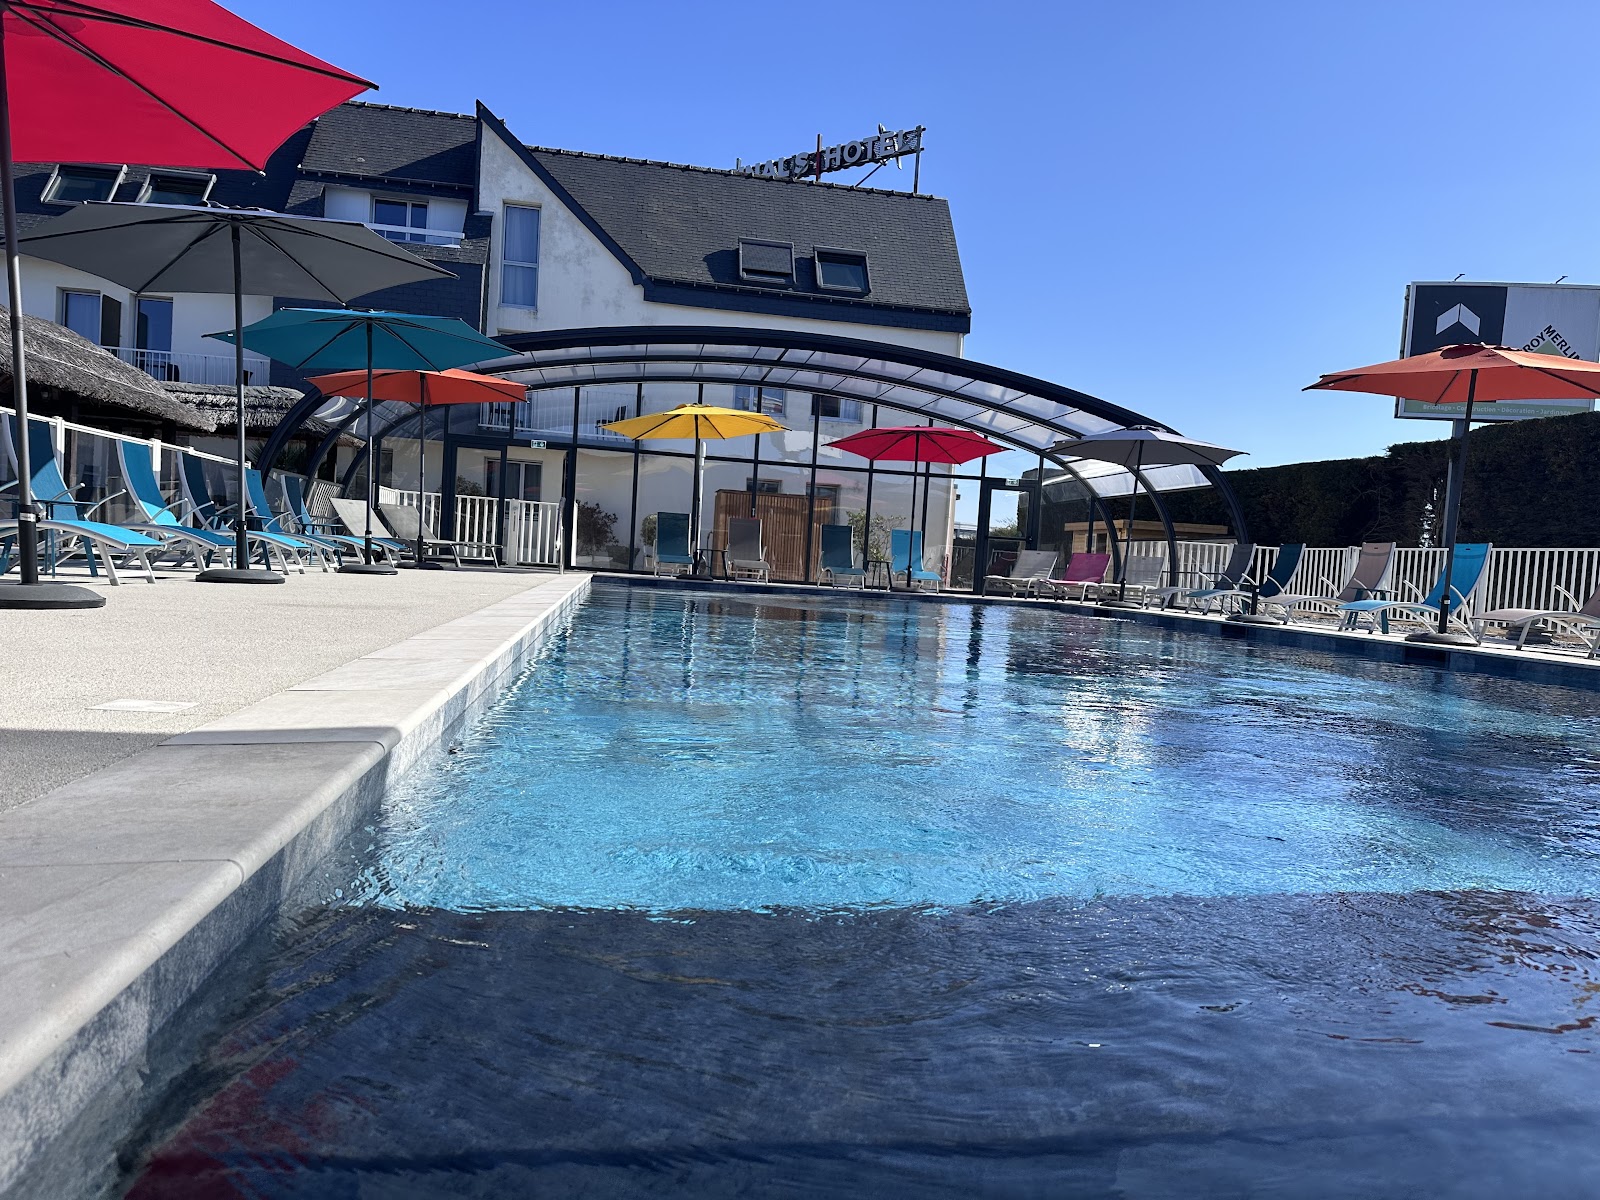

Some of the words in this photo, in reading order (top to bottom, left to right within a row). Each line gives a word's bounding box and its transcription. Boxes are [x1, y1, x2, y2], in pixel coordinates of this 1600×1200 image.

[824, 130, 910, 168] HOTEL
[1522, 332, 1546, 352] ROY
[1456, 405, 1496, 413] Cotruction
[1501, 406, 1535, 414] Décoration
